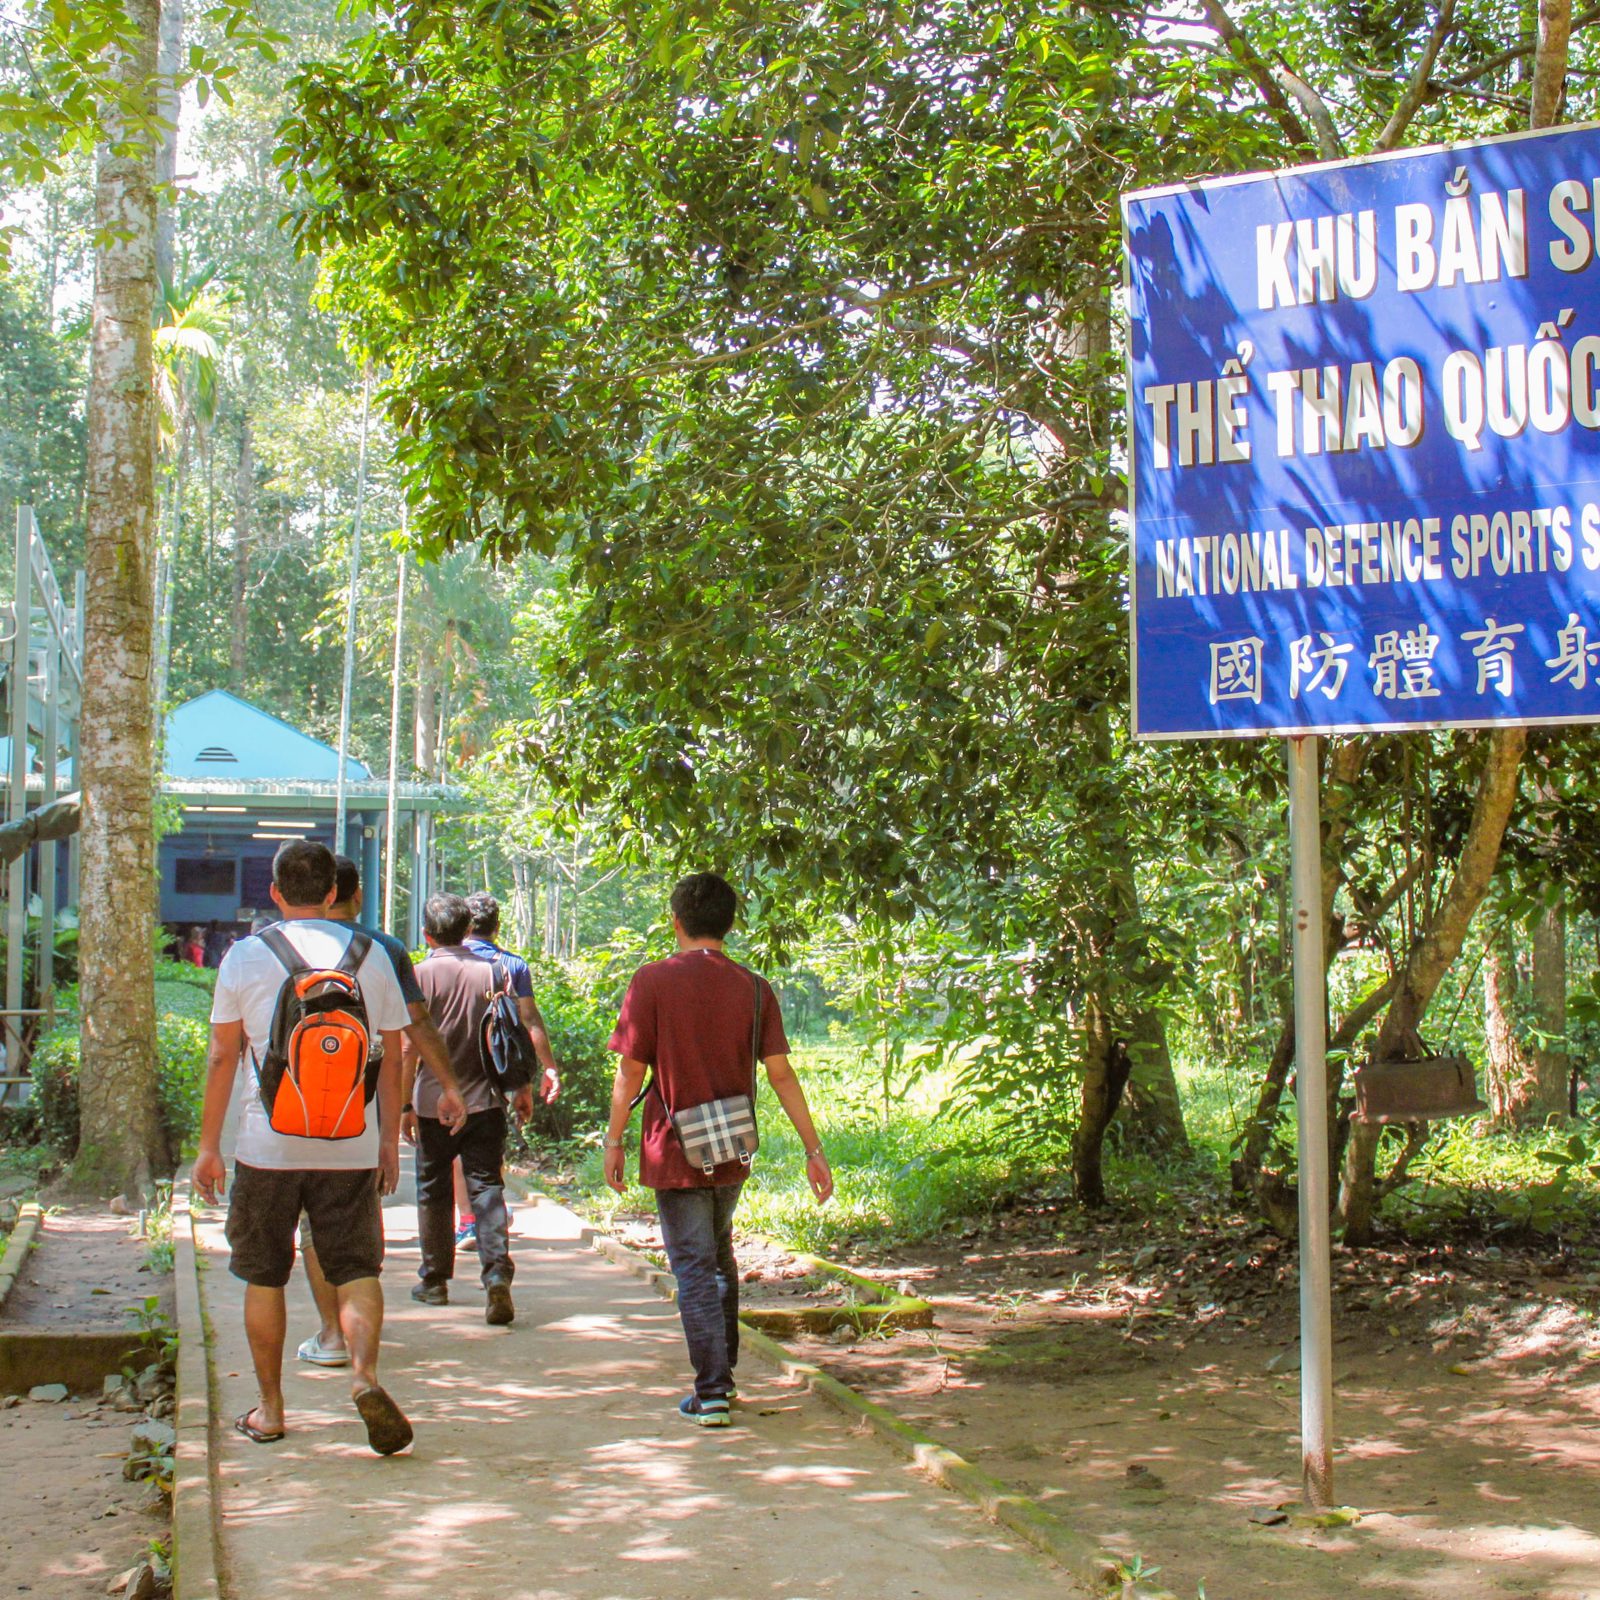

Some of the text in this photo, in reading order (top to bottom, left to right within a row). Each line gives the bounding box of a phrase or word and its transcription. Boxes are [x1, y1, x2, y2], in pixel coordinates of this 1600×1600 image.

[1256, 166, 1600, 310] KHU BẮN S
[1144, 308, 1600, 470] THỂ THAO QUỐC
[1155, 531, 1298, 599] NATIONAL
[1305, 517, 1443, 588] DEFENCE
[1450, 505, 1573, 579] SPORTS
